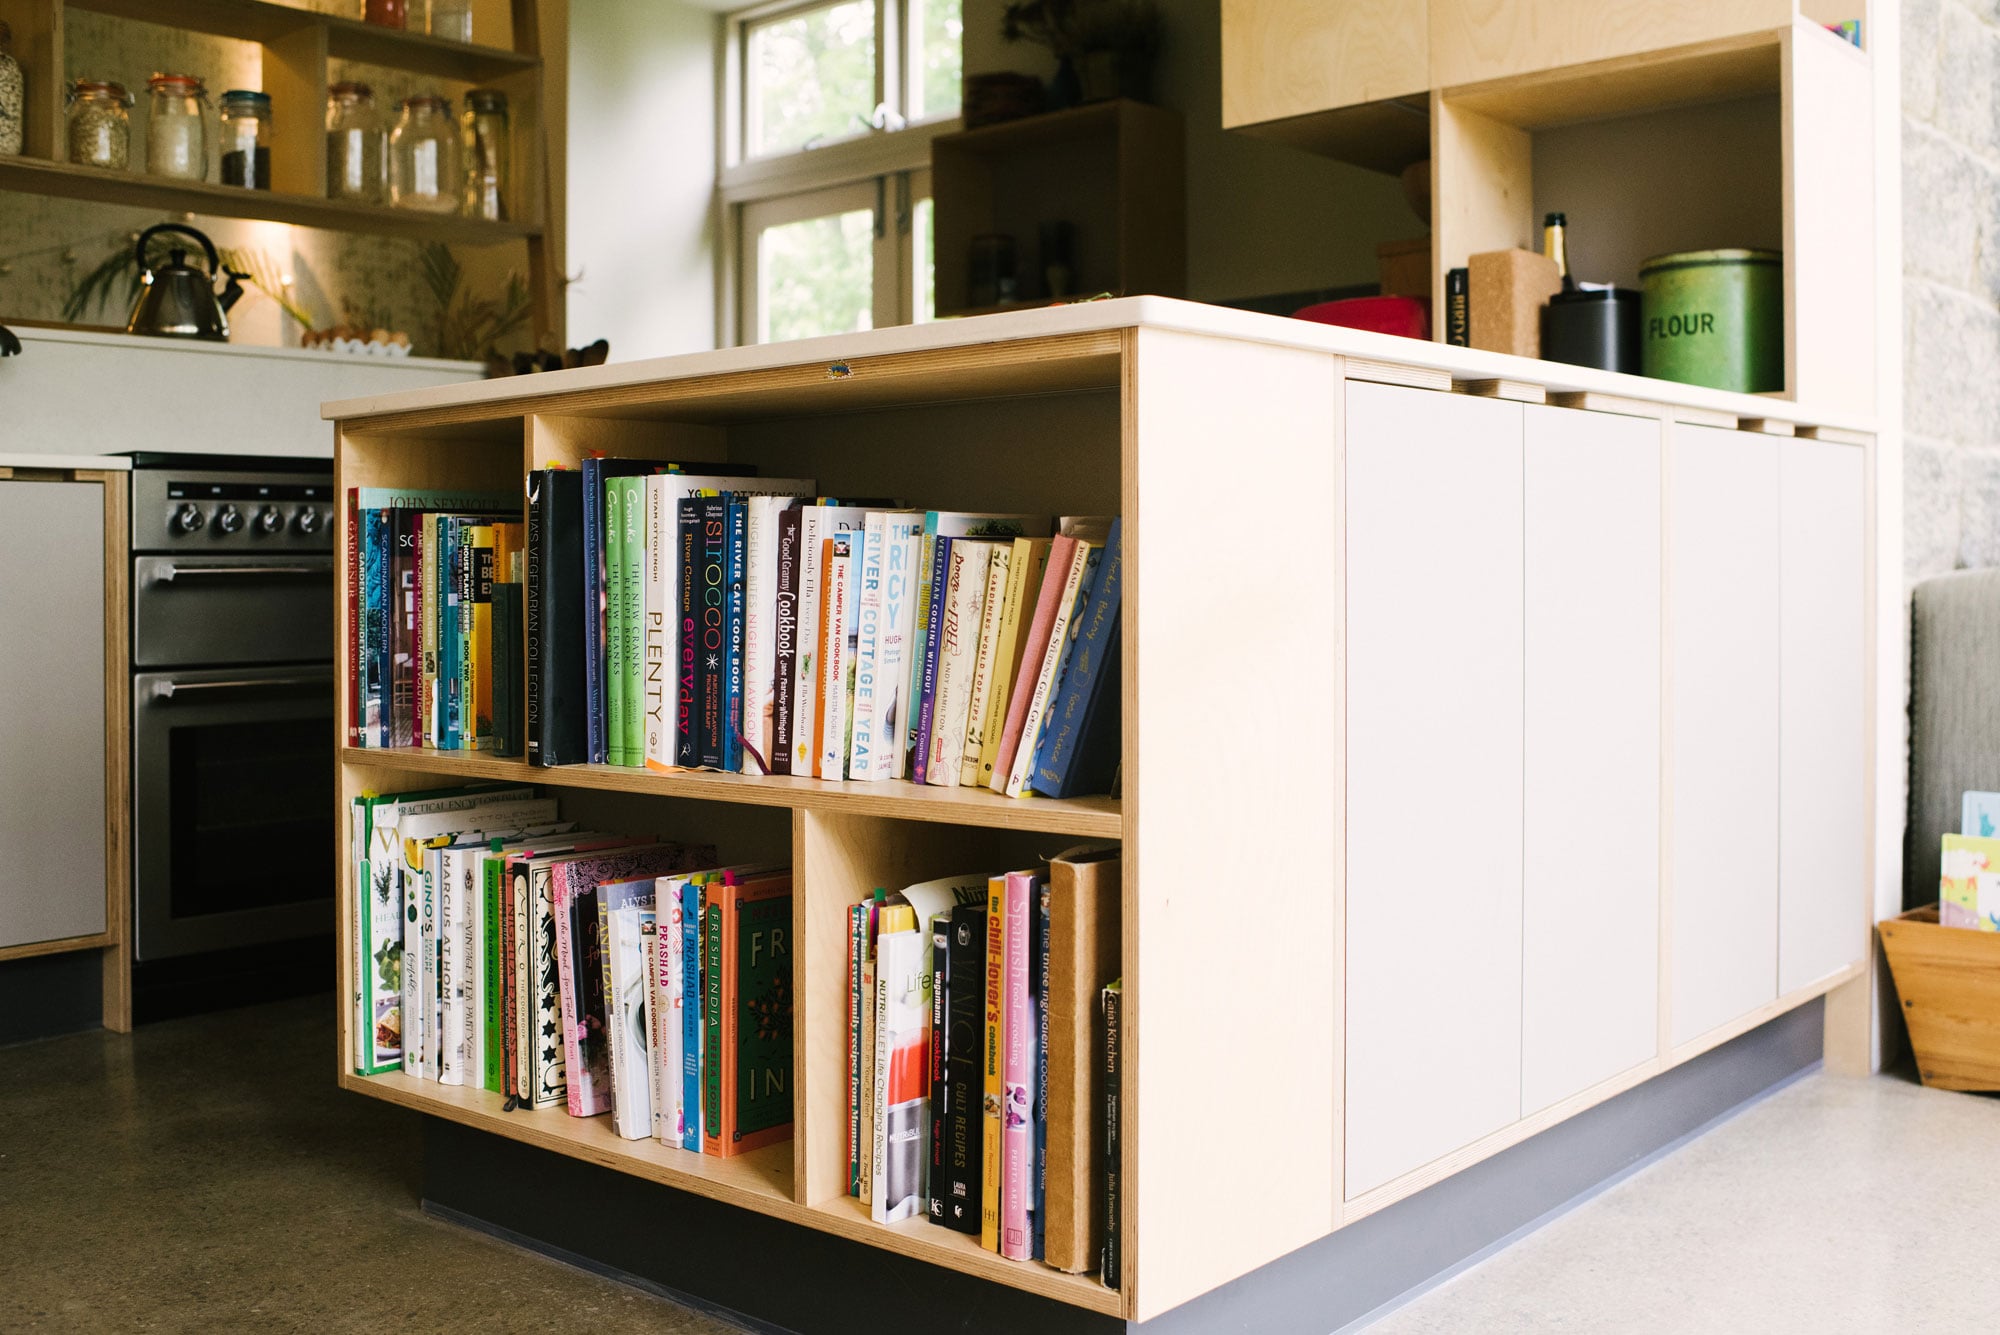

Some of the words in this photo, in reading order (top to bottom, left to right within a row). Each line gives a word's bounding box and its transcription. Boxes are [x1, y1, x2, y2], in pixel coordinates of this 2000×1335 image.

[1649, 313, 1715, 339] FLOUR
[588, 468, 596, 482] The
[588, 524, 597, 542] Food
[606, 489, 620, 545] Cranks
[625, 489, 638, 545] Cranks
[735, 511, 743, 536] THE
[416, 529, 424, 556] JAMES
[682, 533, 694, 563] River
[734, 540, 743, 579] RIVER
[750, 516, 760, 569] NIGELLA
[781, 538, 792, 560] Good
[804, 519, 816, 576] Deliciously
[865, 532, 882, 590] RIVER
[381, 534, 389, 606] SCANDINAVIAN
[416, 558, 424, 595] WONG'S
[588, 549, 597, 586] Cookbook
[612, 562, 620, 589] THE
[631, 561, 640, 590] THE
[779, 560, 792, 592] Granny
[837, 564, 845, 579] THE
[933, 538, 945, 600] VEGETARIAN
[949, 551, 965, 594] Booze
[528, 547, 540, 631] VEGETARIAN
[612, 592, 620, 622] NEW
[624, 577, 632, 622] RECIPE
[682, 565, 694, 612] Cottage
[733, 582, 741, 613] CAFE
[749, 575, 758, 608] BITES
[805, 579, 814, 598] Ella
[835, 581, 844, 615] CAMPER
[984, 573, 998, 633] GARDENERS'
[631, 593, 640, 622] NEW
[777, 591, 797, 659] Cookbook
[803, 601, 813, 626] Every
[834, 617, 842, 635] VAN
[928, 604, 938, 647] COOKING
[416, 597, 424, 658] HOMEGROWN
[624, 627, 632, 663] BOOK
[732, 617, 740, 653] COOK
[747, 614, 758, 674] NIGELLA
[612, 625, 620, 677] CRANKS
[631, 625, 640, 677] CRANKS
[647, 611, 663, 724] PLENTY
[780, 660, 788, 676] Jane
[832, 636, 842, 682] COOKBOOK
[860, 609, 877, 698] COTTAGE
[979, 635, 990, 669] WORLD
[1042, 638, 1060, 679] STUDENT
[528, 637, 539, 724] COLLECTION
[678, 618, 695, 735] everyday
[731, 657, 739, 694] BOOK
[924, 651, 935, 694] WITHOUT
[943, 661, 952, 685] ANDY
[976, 673, 984, 693] TOP
[746, 680, 756, 743] LAWSON
[938, 687, 950, 732] HAMILTON
[971, 696, 981, 721] TIPS
[1034, 681, 1048, 708] GRUB
[920, 702, 929, 731] Barbara
[1024, 709, 1040, 740] GUIDE
[854, 718, 871, 771] YEAR
[918, 732, 927, 761] Cousins
[399, 801, 445, 816] PRACTICAL
[424, 870, 434, 933] GINO'S
[443, 855, 451, 928] MARCUS
[620, 895, 648, 910] ALYS
[991, 896, 999, 913] the
[559, 910, 567, 919] in
[560, 922, 569, 936] the
[597, 902, 611, 958] PLANT
[851, 911, 860, 931] The
[443, 934, 451, 957] AT
[507, 903, 515, 977] NIGELLA
[659, 925, 669, 987] PRASHAD
[710, 913, 719, 967] FRESH
[851, 938, 860, 961] best
[1007, 900, 1028, 978] Spanish
[1042, 928, 1051, 949] the
[443, 960, 451, 1011] HOME
[602, 963, 614, 1006] LOVE
[648, 957, 656, 988] CAMPER
[686, 937, 696, 999] PRASHAD
[851, 963, 859, 989] ever
[906, 972, 932, 993] Life
[1042, 952, 1051, 987] three
[464, 978, 474, 1002] TEA
[565, 995, 574, 1021] Food
[615, 987, 623, 1028] DISCOVER
[710, 974, 719, 1027] INDIA
[933, 970, 943, 1025] wagamama
[1012, 982, 1022, 1009] food
[464, 1006, 474, 1044] PARTY
[508, 985, 517, 1057] EXPRESS
[650, 1007, 658, 1048] COOKBOOK
[851, 992, 860, 1030] family
[951, 958, 976, 1074] VENICE
[1039, 989, 1050, 1055] ingredient
[1106, 993, 1117, 1028] Gaia's
[865, 1015, 873, 1050] WORLD
[987, 1025, 997, 1076] cookbook
[1009, 1023, 1022, 1066] cooking
[1106, 1028, 1118, 1073] Kitchen
[850, 1032, 859, 1075] recipes
[864, 1054, 872, 1062] in
[877, 1058, 886, 1075] Life
[933, 1030, 943, 1083] cookbook
[851, 1076, 859, 1107] from
[864, 1065, 872, 1084] Your
[864, 1087, 872, 1118] Kitchen
[875, 1078, 886, 1132] Changing
[955, 1082, 968, 1112] CULT
[851, 1108, 859, 1165] Mumsnet
[954, 1115, 967, 1168] RECIPES
[874, 1134, 886, 1177] Recipes
[1010, 1149, 1018, 1184] PEPITA
[1010, 1186, 1018, 1211] ARIS
[1107, 1171, 1116, 1191] Julia
